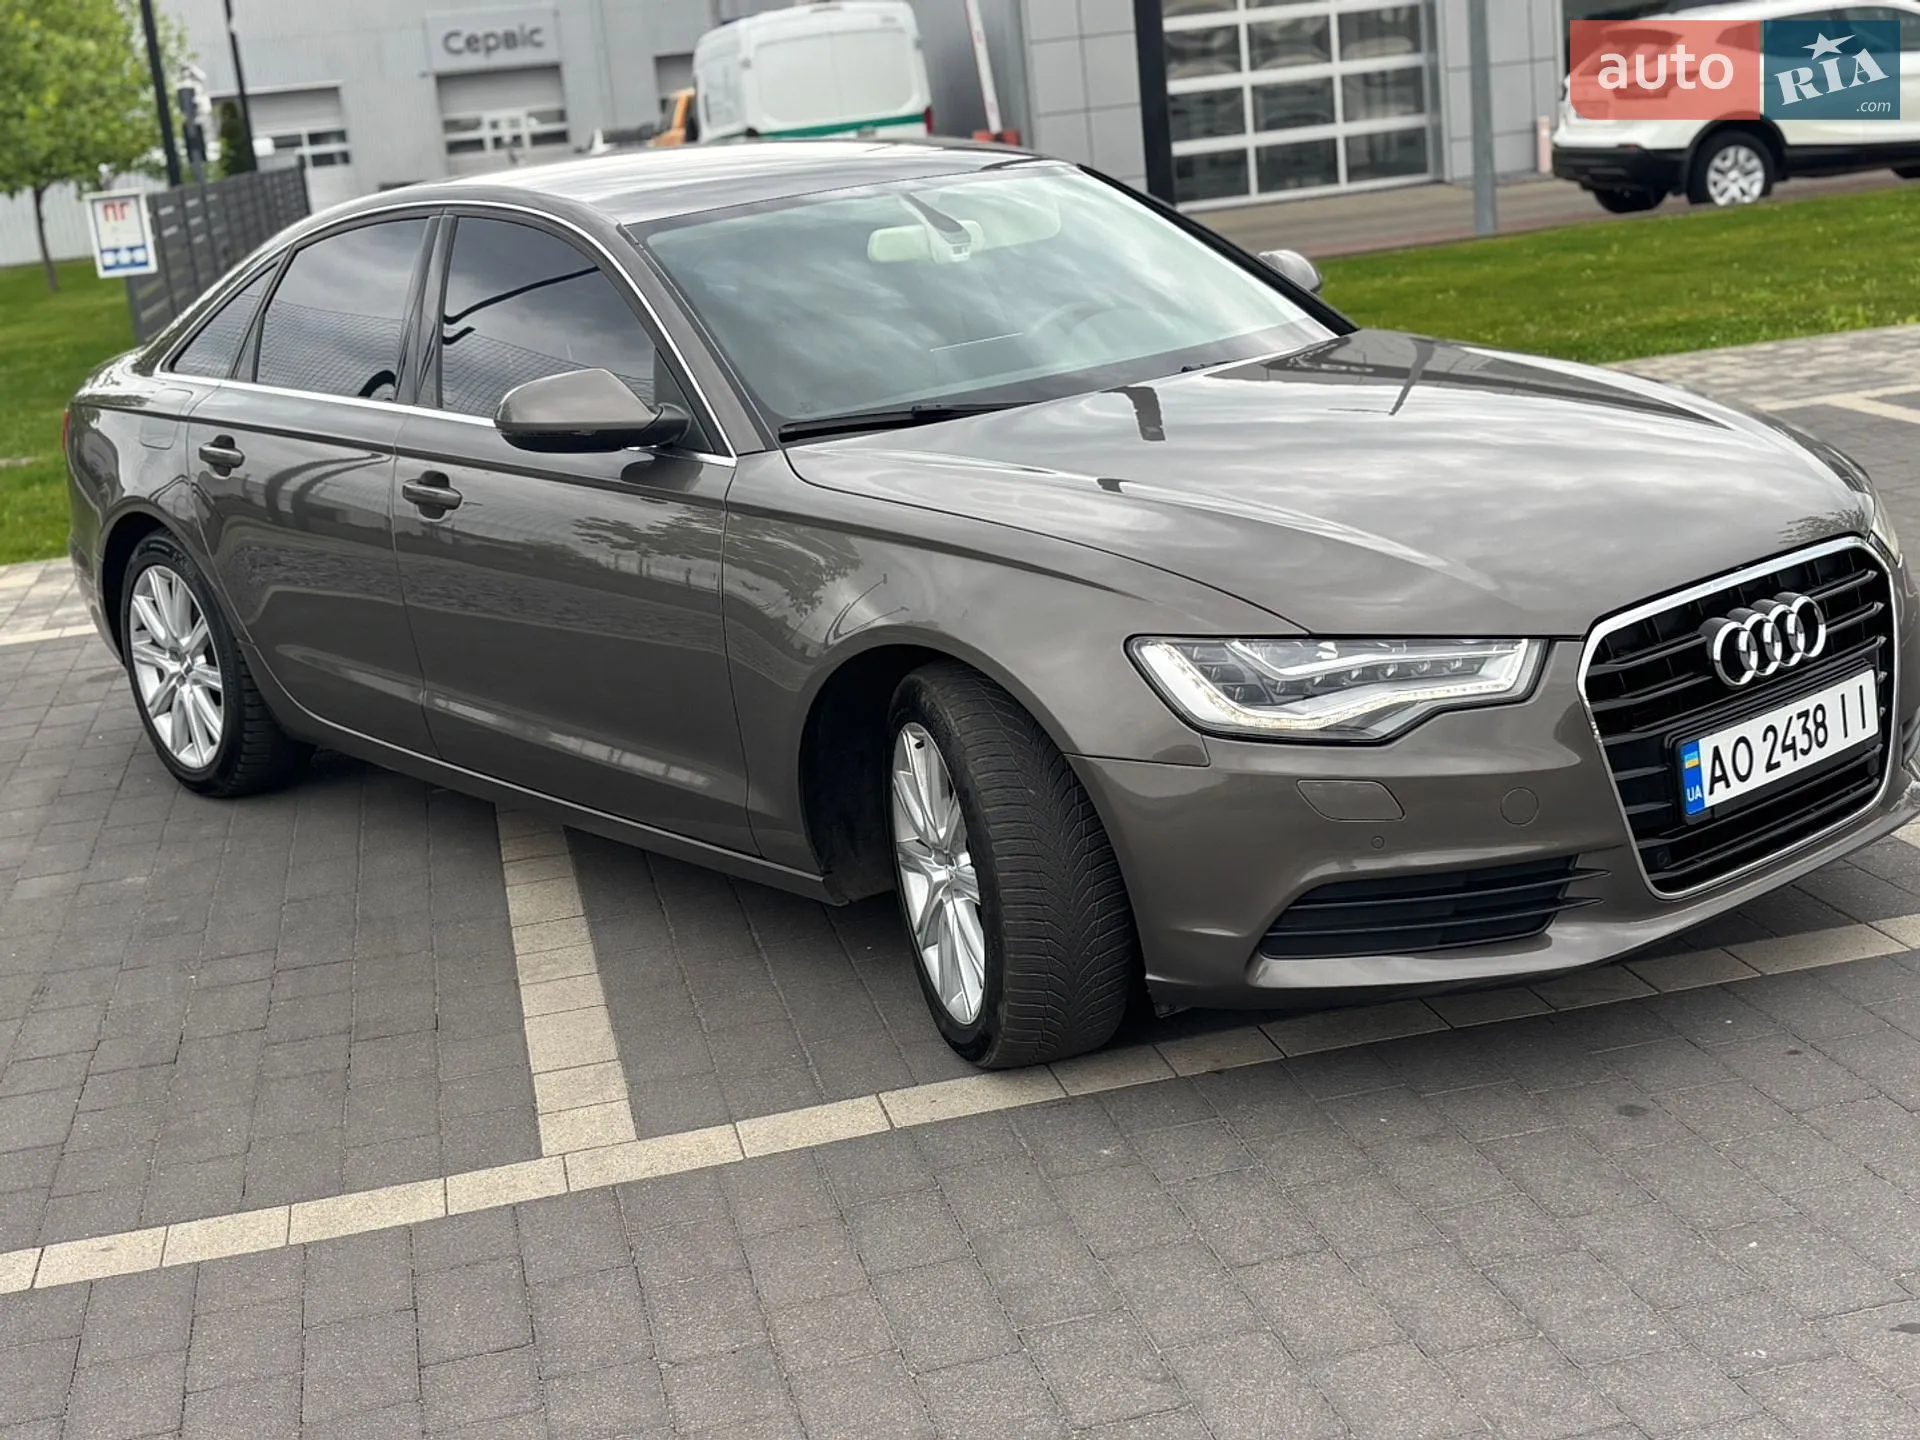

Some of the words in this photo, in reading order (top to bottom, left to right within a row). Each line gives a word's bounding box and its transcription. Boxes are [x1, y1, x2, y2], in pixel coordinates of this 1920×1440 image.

[442, 23, 545, 60] Сервіс
[1708, 735, 1754, 796] AO
[1762, 703, 1828, 774] 2438
[1686, 785, 1703, 802] UA
